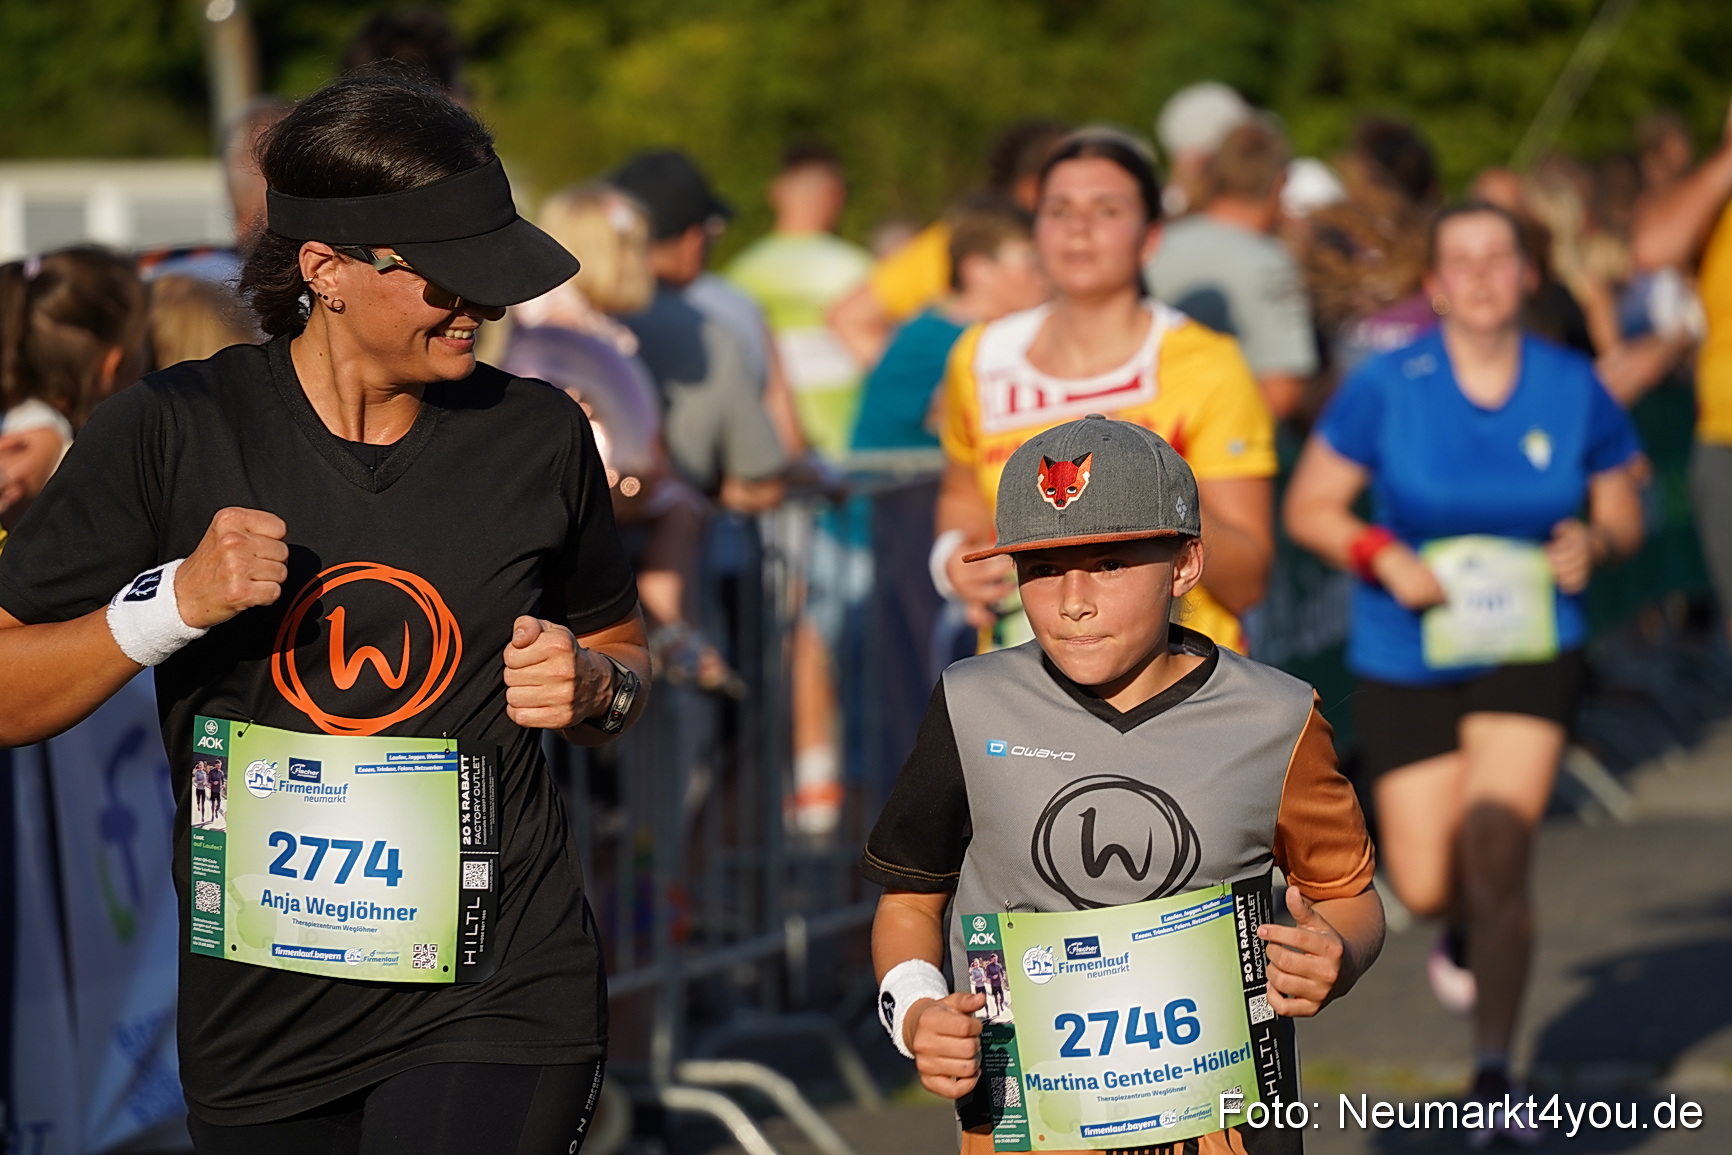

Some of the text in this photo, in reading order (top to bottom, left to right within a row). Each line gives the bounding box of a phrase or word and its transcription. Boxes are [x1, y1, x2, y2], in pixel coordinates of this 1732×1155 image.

[197, 736, 224, 750] AOK
[290, 763, 320, 777] Fischer
[279, 780, 349, 795] Firmenlauf
[303, 795, 347, 803] neumarkt
[461, 754, 472, 845] 20 % RABATT
[472, 756, 482, 845] FACTORY OUTLET
[268, 831, 403, 887] 2774
[261, 889, 418, 922] Anja Weglöhner
[1247, 893, 1258, 933] OUTLET
[292, 918, 378, 933] Therapiezentrum Weglöhner
[463, 896, 480, 965] HILTL
[969, 932, 997, 946] AOK
[1067, 941, 1099, 954] Fischer
[1235, 895, 1254, 983] 20 % RABATT
[274, 946, 342, 961] firmenlauf.bayern
[363, 955, 400, 964] Firmenlauf
[1058, 952, 1130, 974] Firmenlauf
[1252, 935, 1264, 980] FACTORY
[1087, 964, 1131, 979] neumarkt
[1054, 998, 1201, 1058] 2746
[1025, 1042, 1252, 1092] Martina Gentele-Höllerl
[1259, 1027, 1279, 1097] HILTL
[1096, 1085, 1188, 1103] Therapiezentrum Weglöhner
[1178, 1107, 1213, 1122] Firmenlauf
[1083, 1118, 1157, 1137] firmenlauf.bayern
